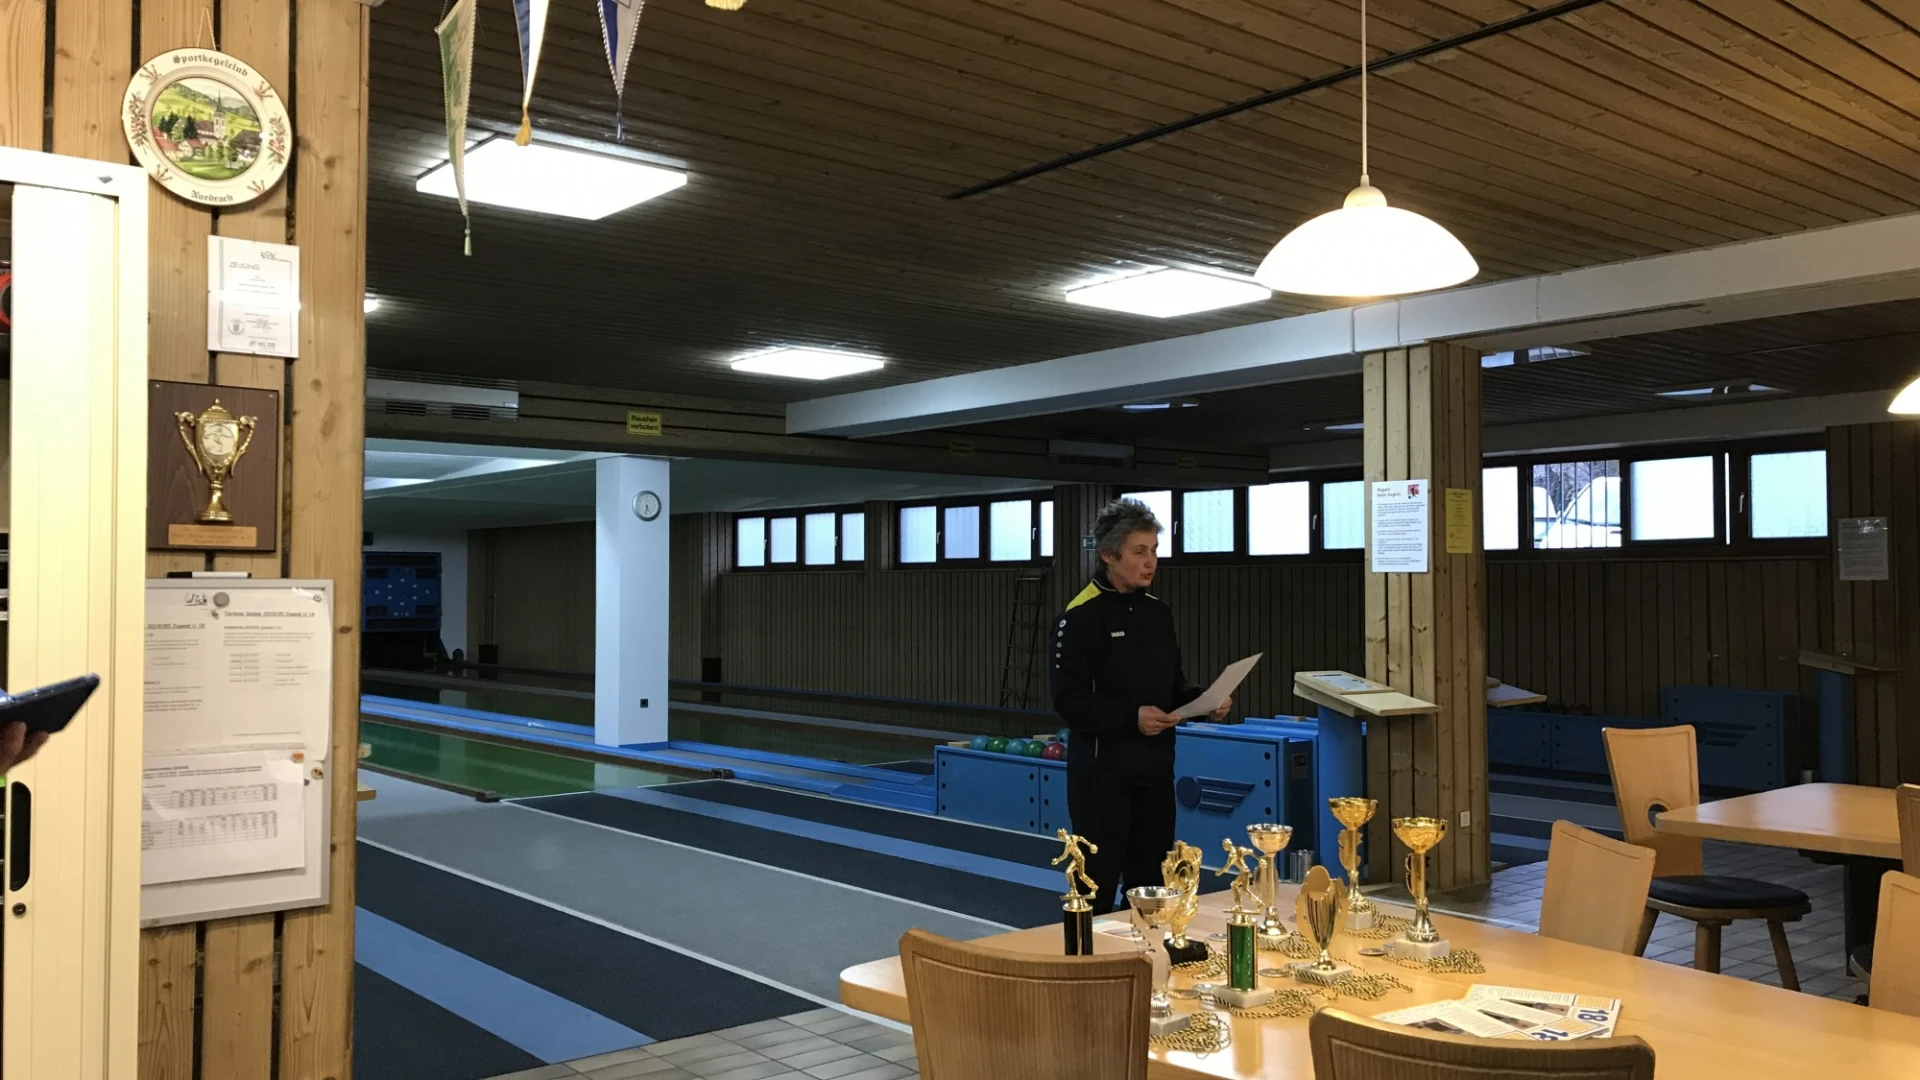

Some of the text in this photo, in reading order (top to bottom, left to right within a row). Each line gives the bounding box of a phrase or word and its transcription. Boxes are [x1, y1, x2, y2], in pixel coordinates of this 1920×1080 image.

[172, 54, 248, 76] Sportkegelclub
[191, 189, 234, 203] Nordrach
[1577, 1009, 1609, 1022] 18
